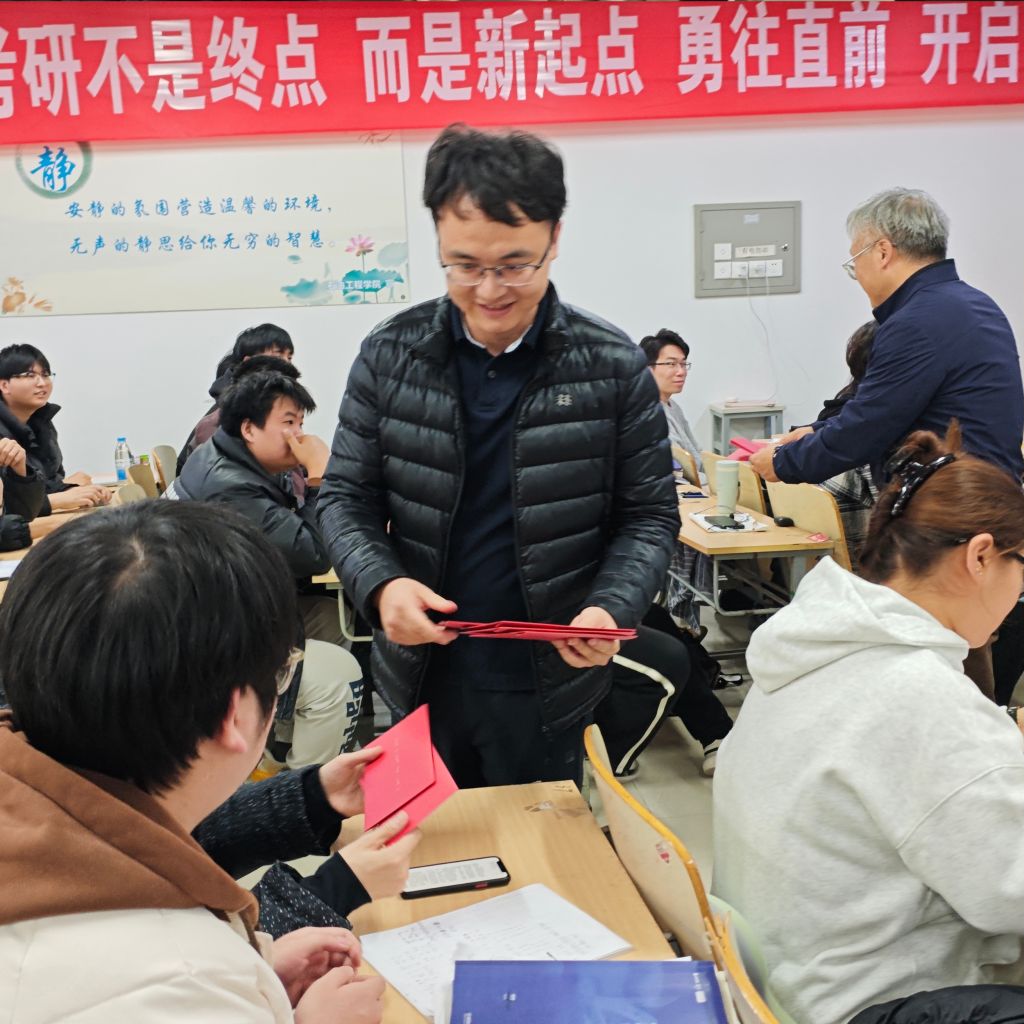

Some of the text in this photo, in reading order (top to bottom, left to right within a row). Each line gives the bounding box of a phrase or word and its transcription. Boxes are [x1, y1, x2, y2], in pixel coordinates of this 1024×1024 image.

[356, 5, 645, 104] 而是新起点
[677, 1, 891, 93] 勇往直前
[920, 2, 1019, 85] 开启
[30, 145, 76, 192] 静
